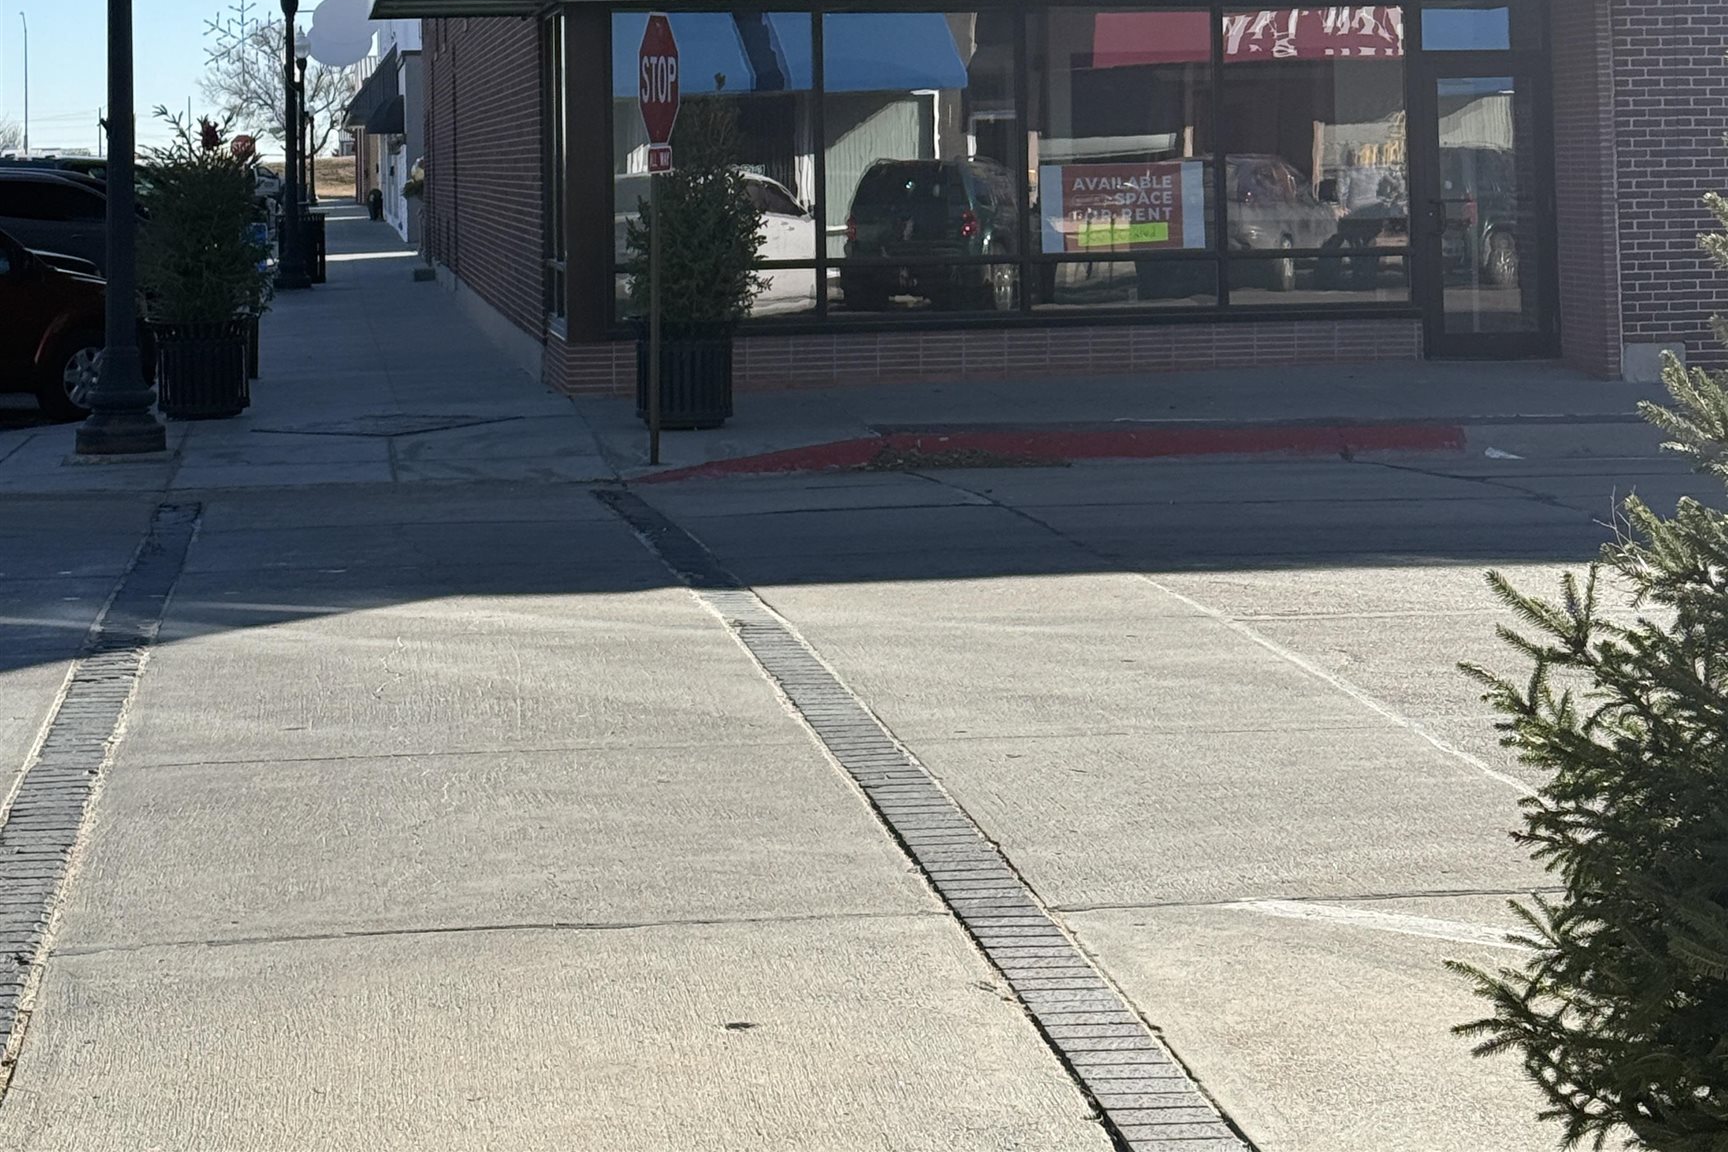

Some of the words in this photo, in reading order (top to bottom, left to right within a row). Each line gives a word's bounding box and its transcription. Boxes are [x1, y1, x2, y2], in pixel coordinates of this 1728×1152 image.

[641, 55, 677, 104] STOP
[1072, 175, 1172, 191] AVAILABLE
[1115, 191, 1173, 205] SPACE
[1121, 207, 1173, 221] RENT
